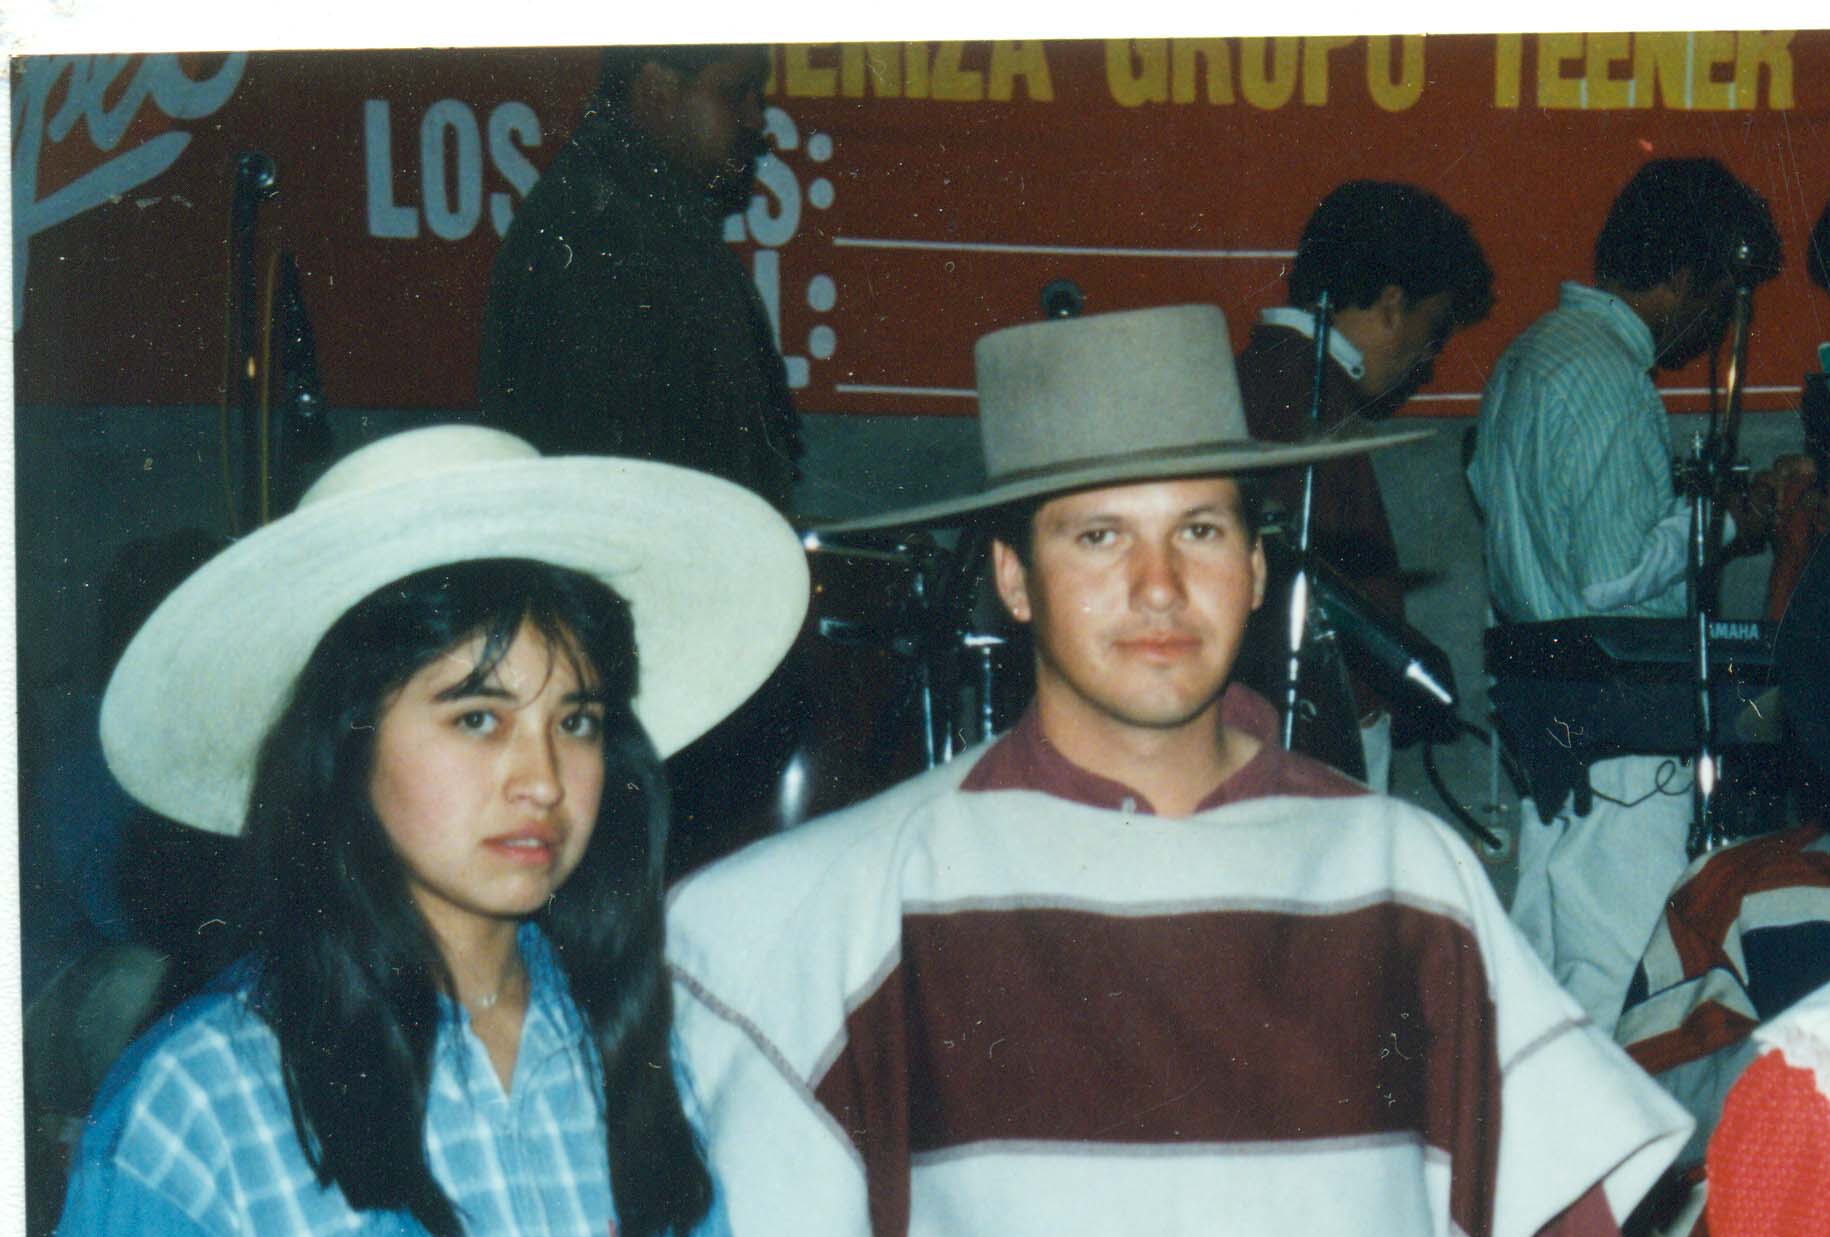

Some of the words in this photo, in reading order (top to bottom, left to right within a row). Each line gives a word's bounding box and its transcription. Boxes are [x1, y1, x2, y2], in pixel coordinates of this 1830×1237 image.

[765, 41, 1053, 102] ENIZA
[364, 99, 543, 241] LOS
[1709, 622, 1759, 640] AMAHA
